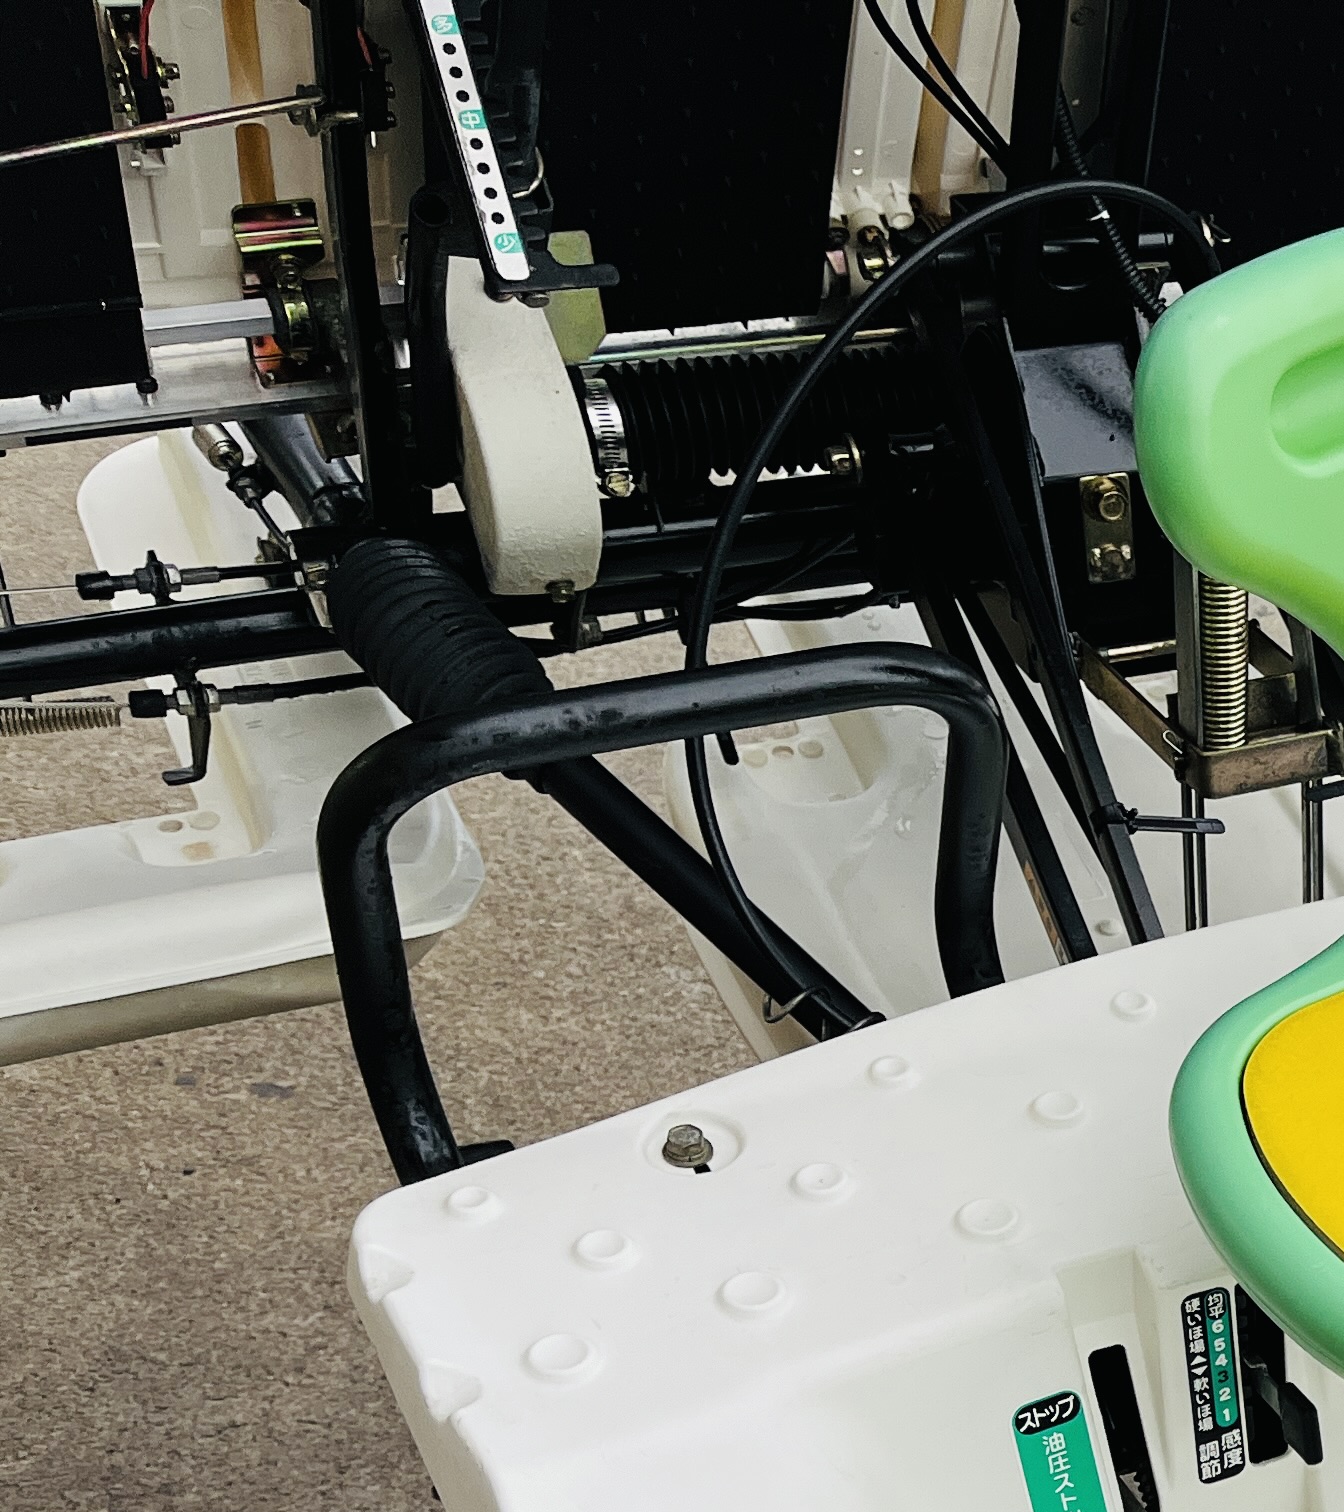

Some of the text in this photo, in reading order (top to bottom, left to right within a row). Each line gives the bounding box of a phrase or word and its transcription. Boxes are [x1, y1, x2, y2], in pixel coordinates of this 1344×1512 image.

[434, 15, 453, 33] 多
[461, 111, 480, 129] 中
[498, 233, 517, 253] 少
[1207, 1292, 1226, 1319] 均平
[1185, 1297, 1206, 1354] 硬いほ場
[1212, 1319, 1232, 1422] 6 5 4 3 2 1
[1018, 1394, 1075, 1433] ストップ
[1193, 1376, 1214, 1432] 軟いほ場
